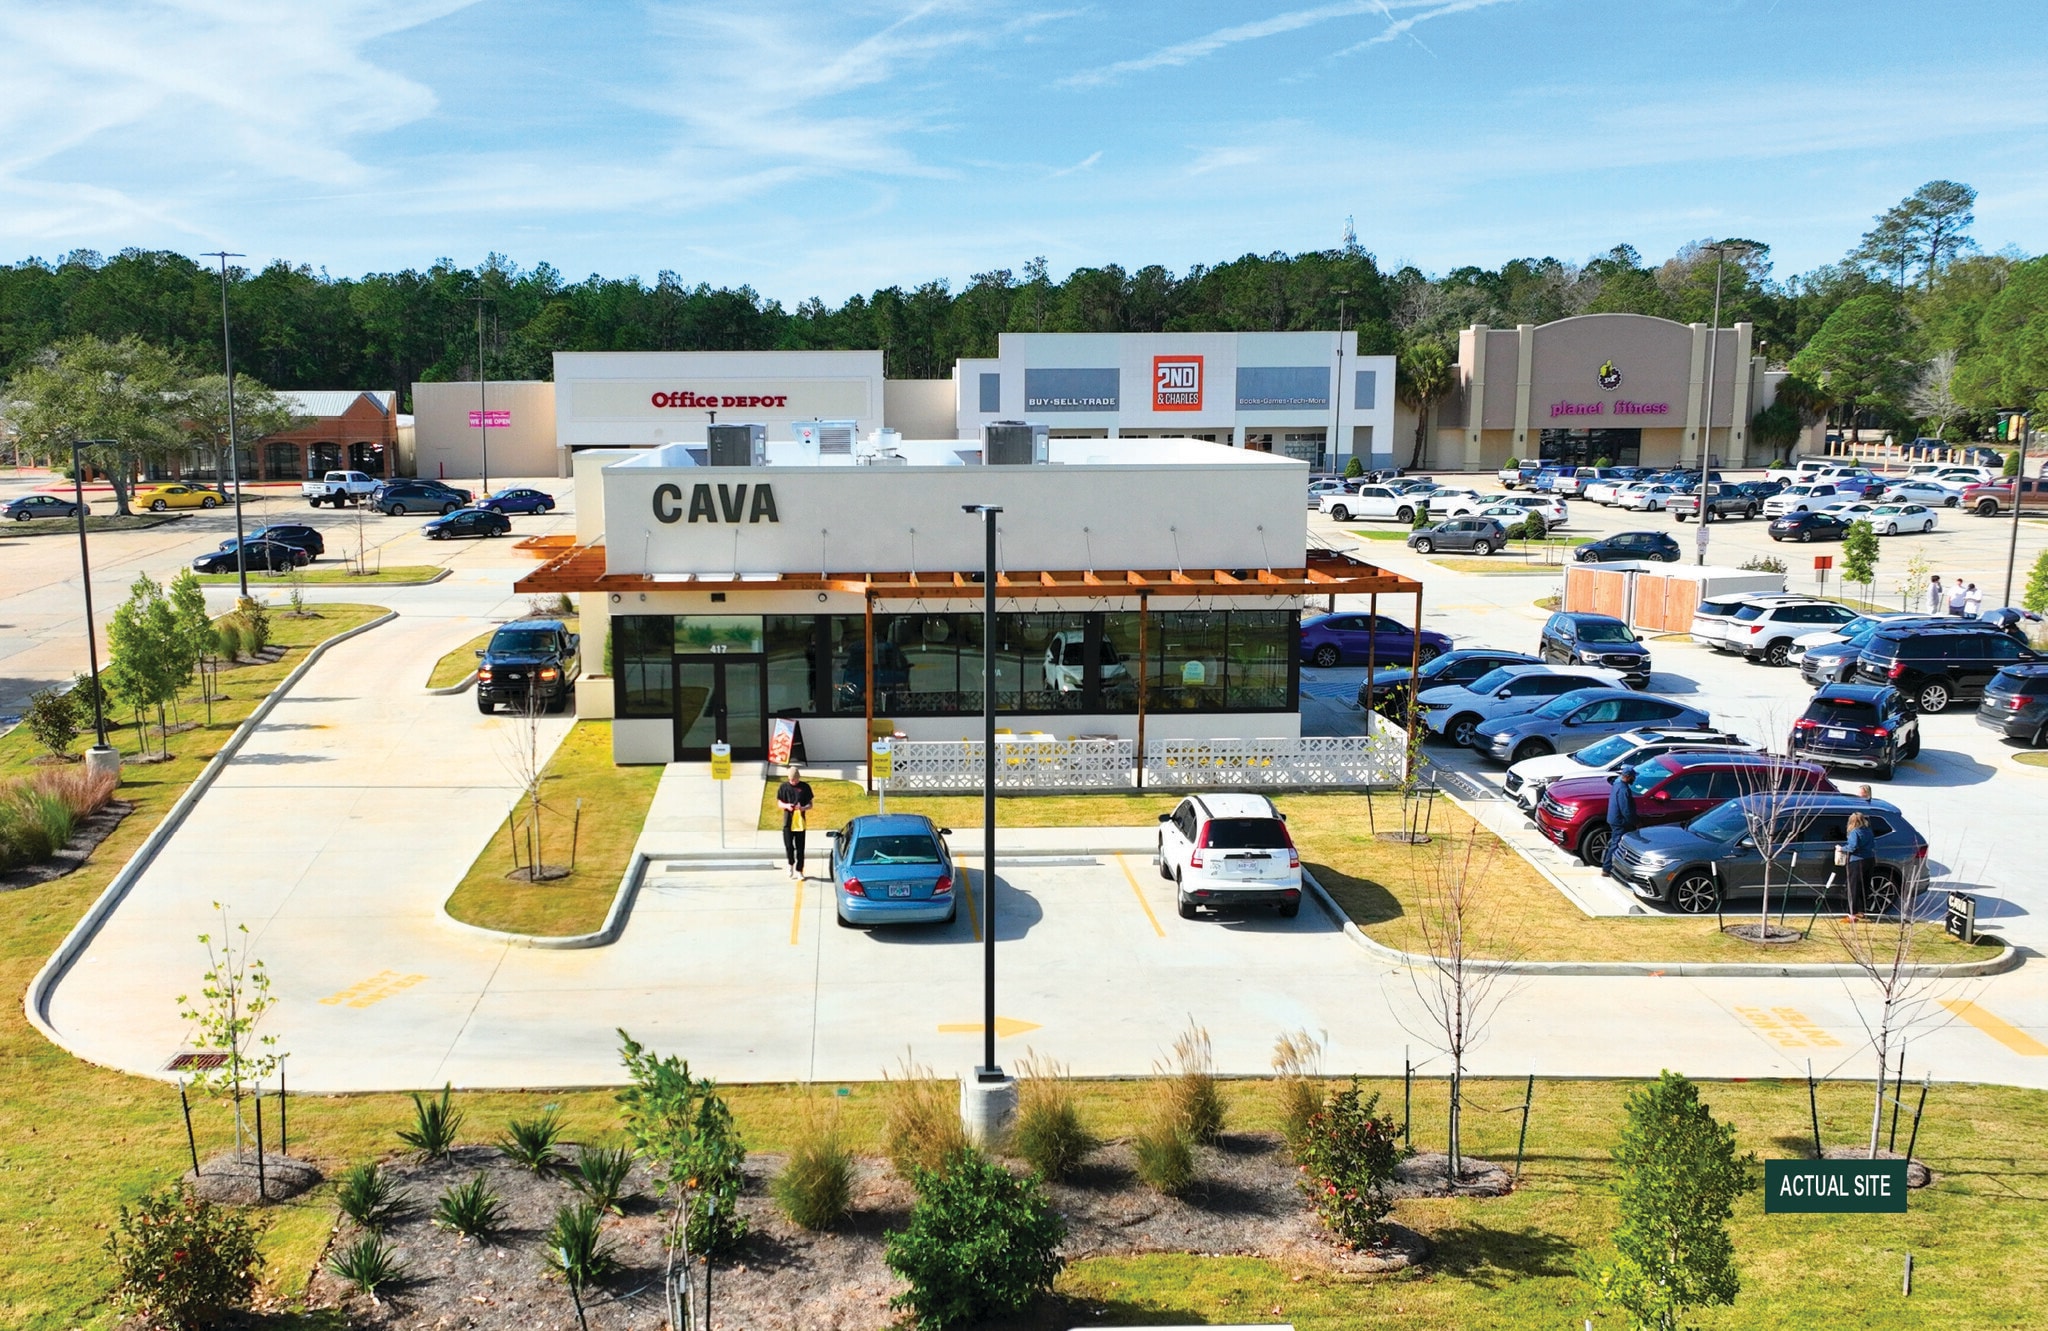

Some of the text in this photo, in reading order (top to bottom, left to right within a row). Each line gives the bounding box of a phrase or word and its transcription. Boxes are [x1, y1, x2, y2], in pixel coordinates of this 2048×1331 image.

[1158, 366, 1198, 393] 2ND
[651, 391, 787, 408] Office DEPOT
[1157, 393, 1198, 404] & CHARLES
[1550, 400, 1669, 417] planet fitness
[652, 484, 779, 524] CAVA
[710, 644, 728, 654] 417
